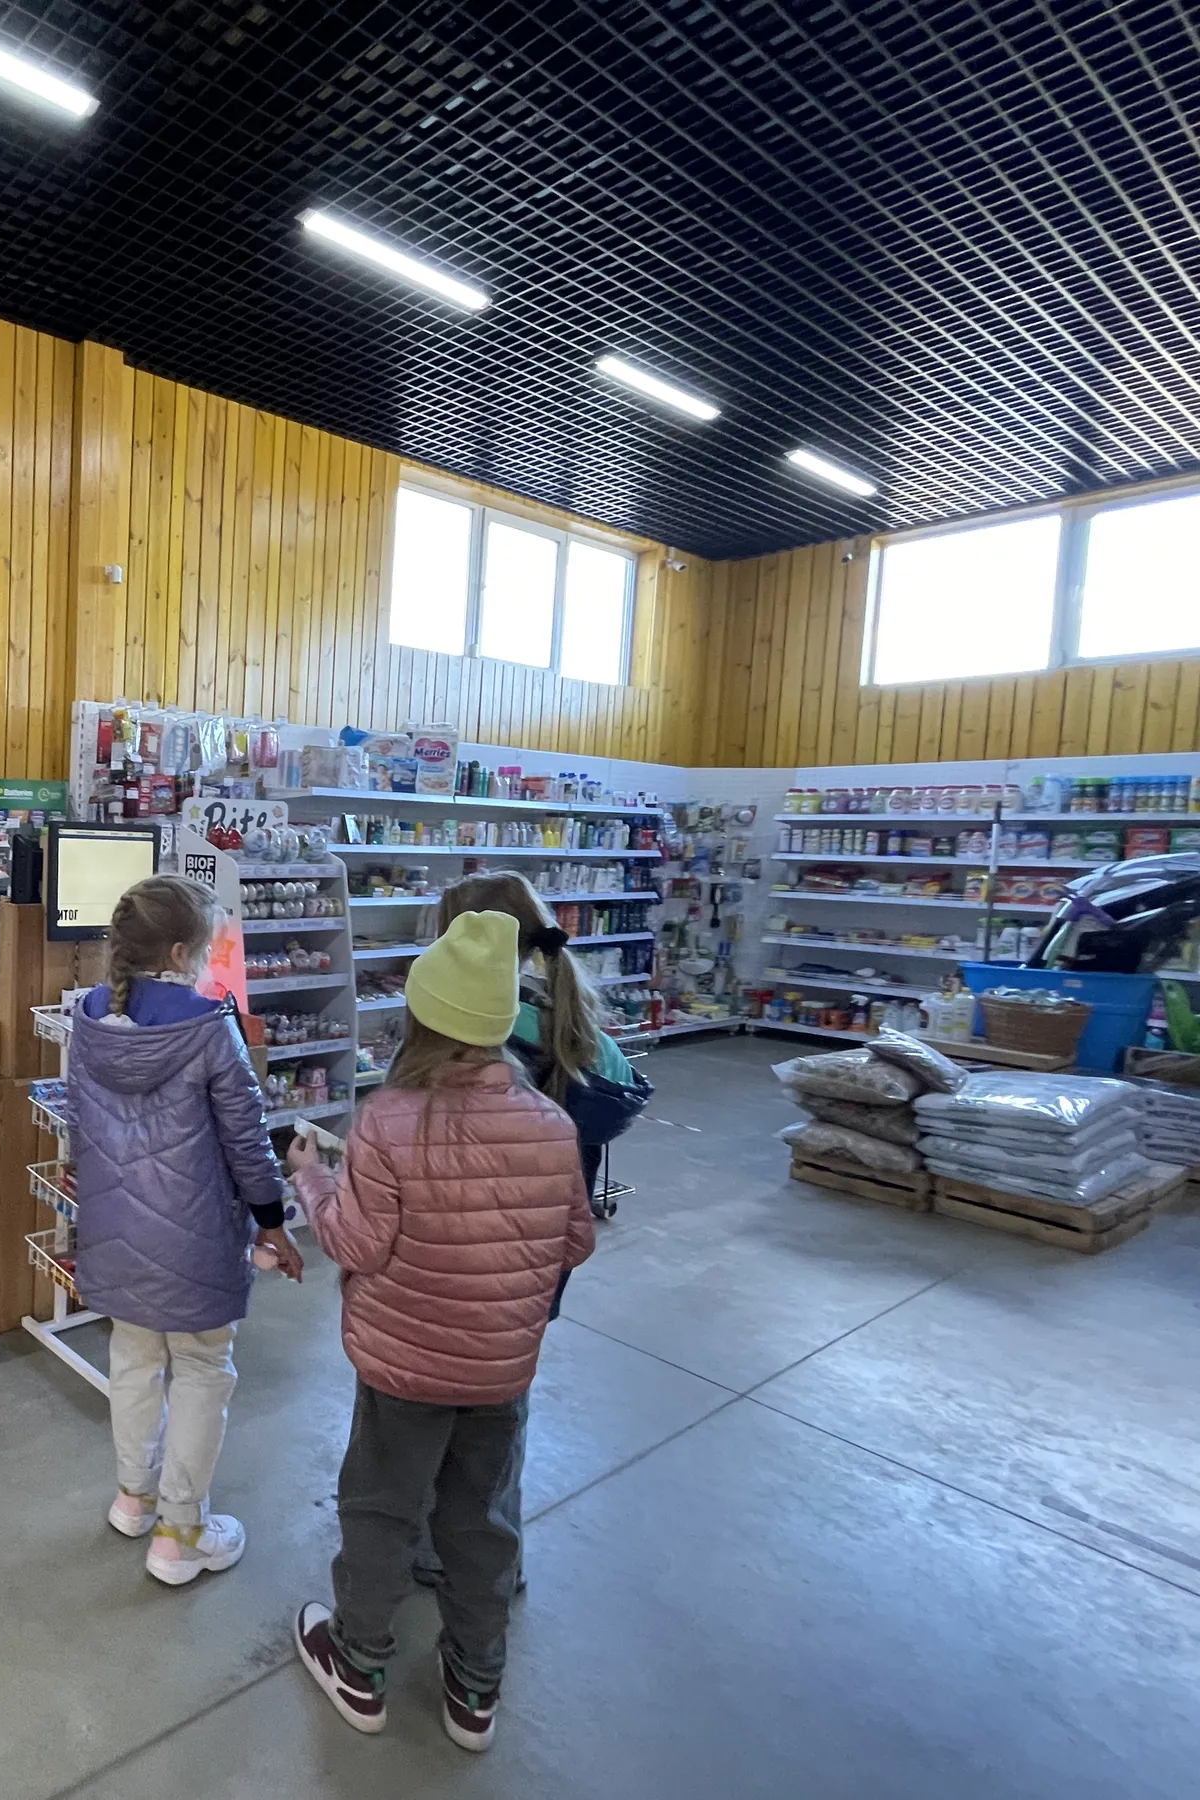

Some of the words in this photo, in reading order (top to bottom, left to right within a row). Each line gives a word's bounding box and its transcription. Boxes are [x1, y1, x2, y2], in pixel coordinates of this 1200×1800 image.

[414, 747, 451, 758] Merries
[186, 856, 215, 870] BIOF
[58, 909, 78, 921] ИТОГ
